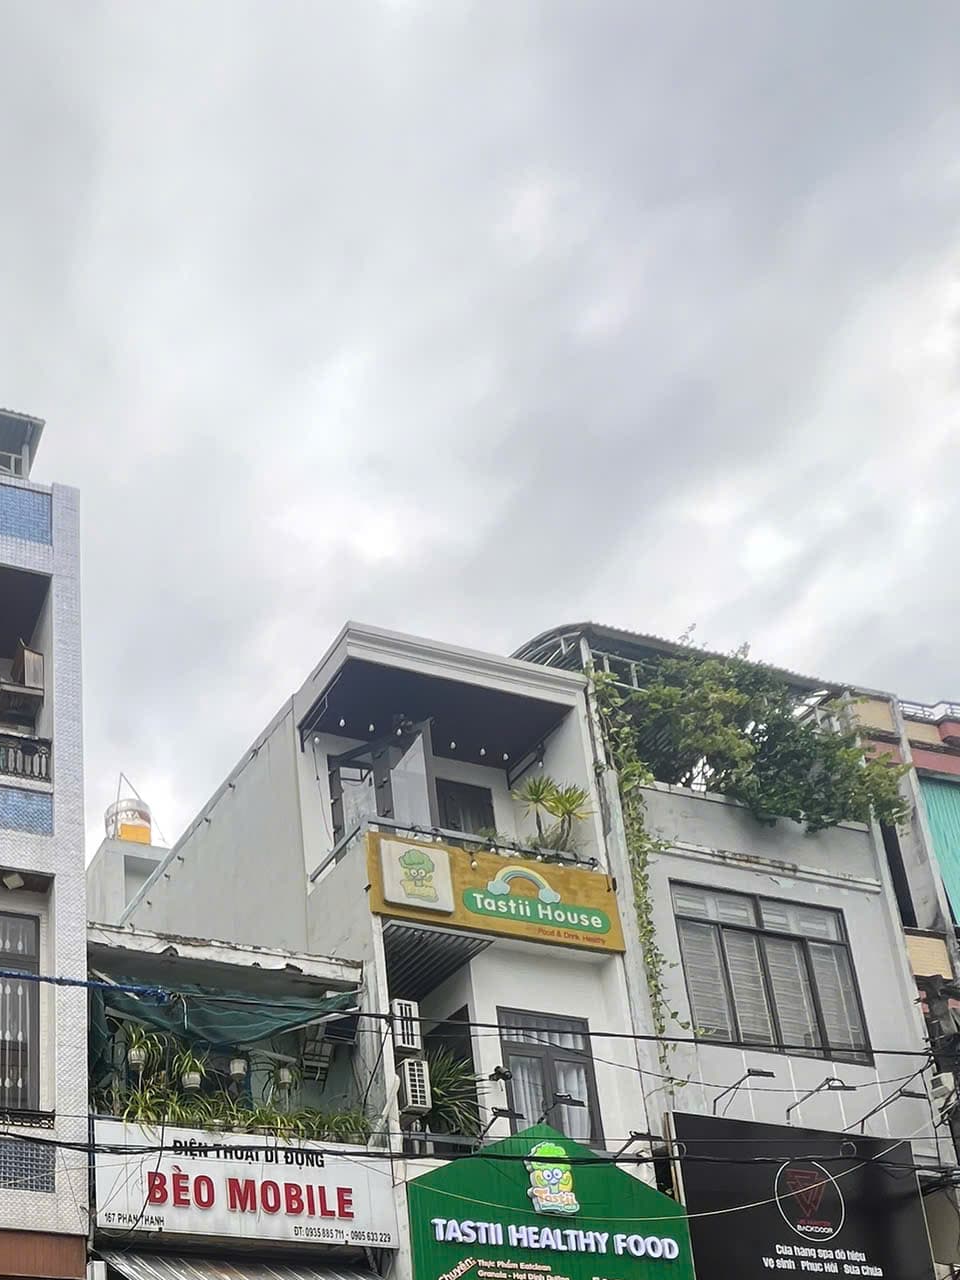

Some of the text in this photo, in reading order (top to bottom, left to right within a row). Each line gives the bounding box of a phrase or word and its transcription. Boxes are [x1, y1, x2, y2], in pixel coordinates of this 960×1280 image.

[473, 893, 602, 928] Tastii House
[146, 1165, 355, 1220] BÈO MOBILE
[104, 1212, 165, 1226] 167 PHAN THANH
[351, 1230, 366, 1241] 0905
[797, 1224, 833, 1234] BACKDOOR
[431, 1217, 680, 1260] TASTII HEALTHY FOOD
[817, 1248, 834, 1260] spa
[775, 1257, 796, 1270] sinh
